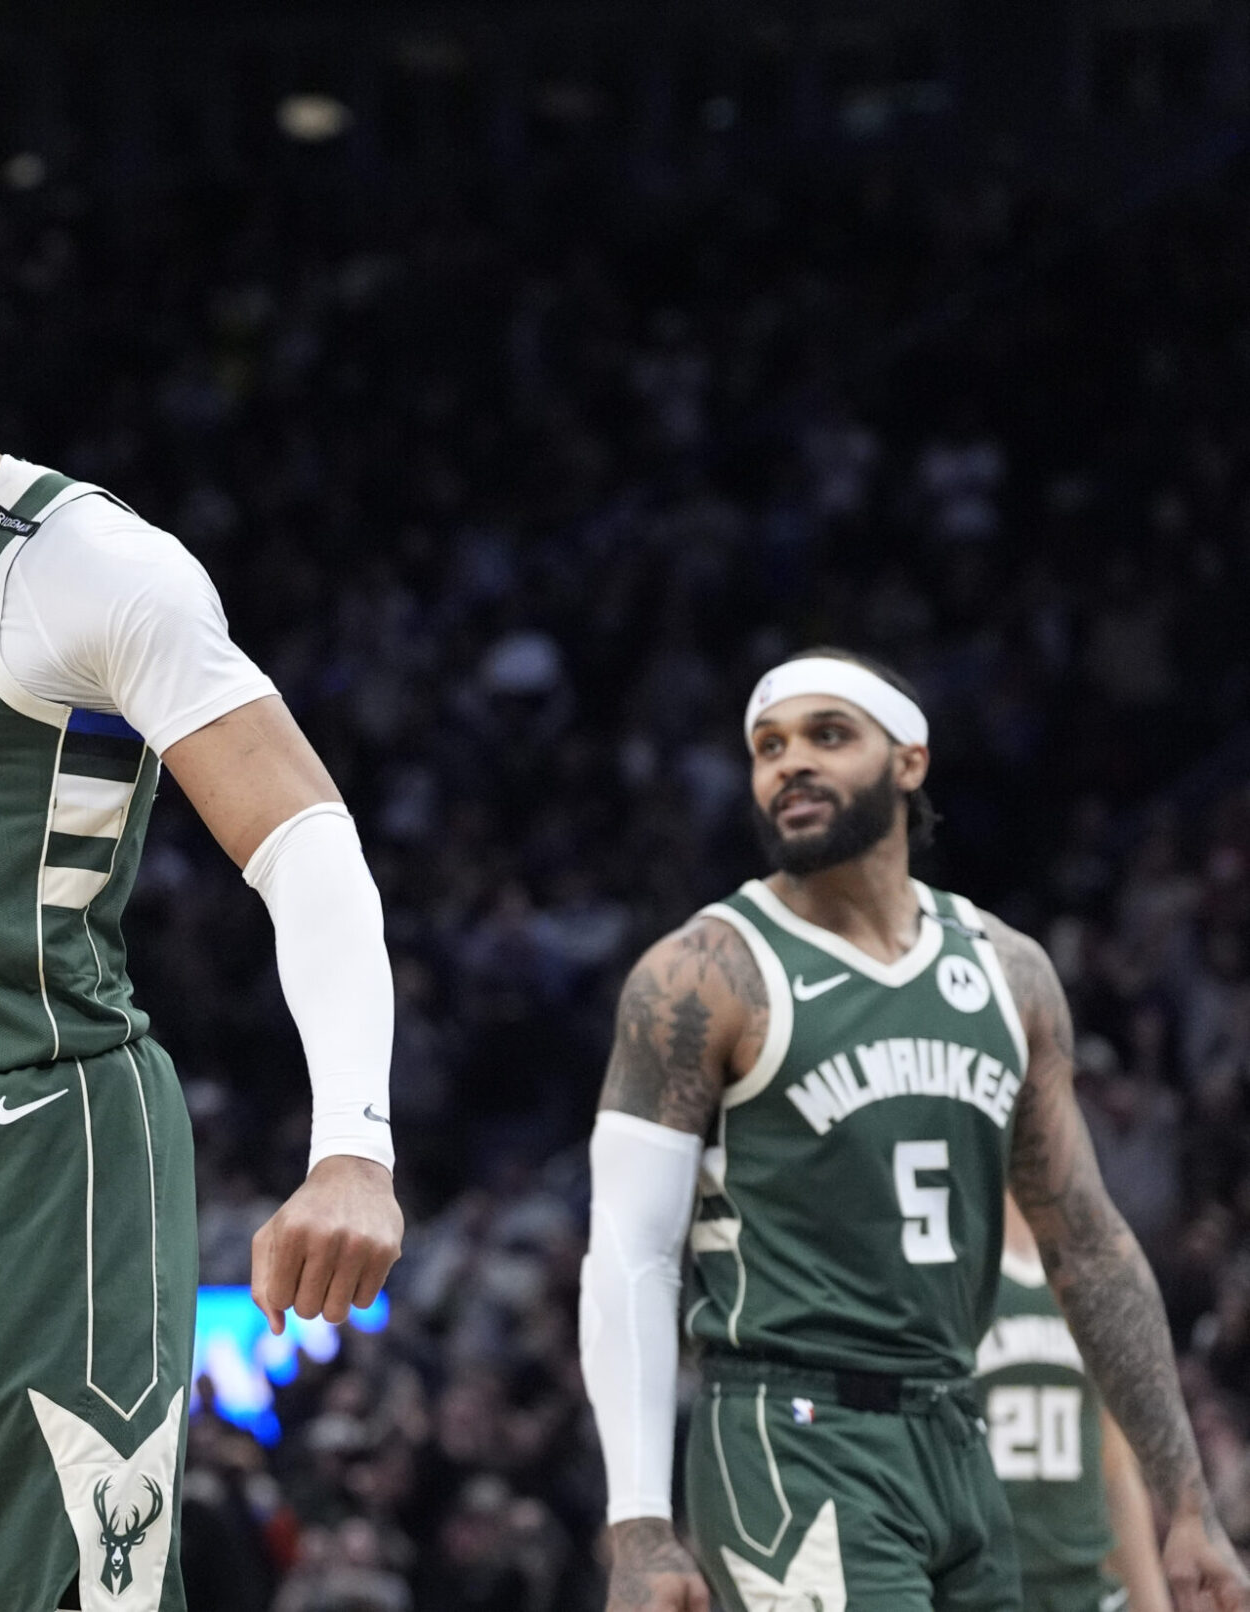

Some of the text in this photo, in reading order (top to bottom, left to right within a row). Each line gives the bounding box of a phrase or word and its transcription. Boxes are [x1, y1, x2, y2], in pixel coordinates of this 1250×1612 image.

[785, 1038, 1021, 1136] MILWAUKEE
[894, 1140, 957, 1264] 5
[988, 1385, 1082, 1481] 20
